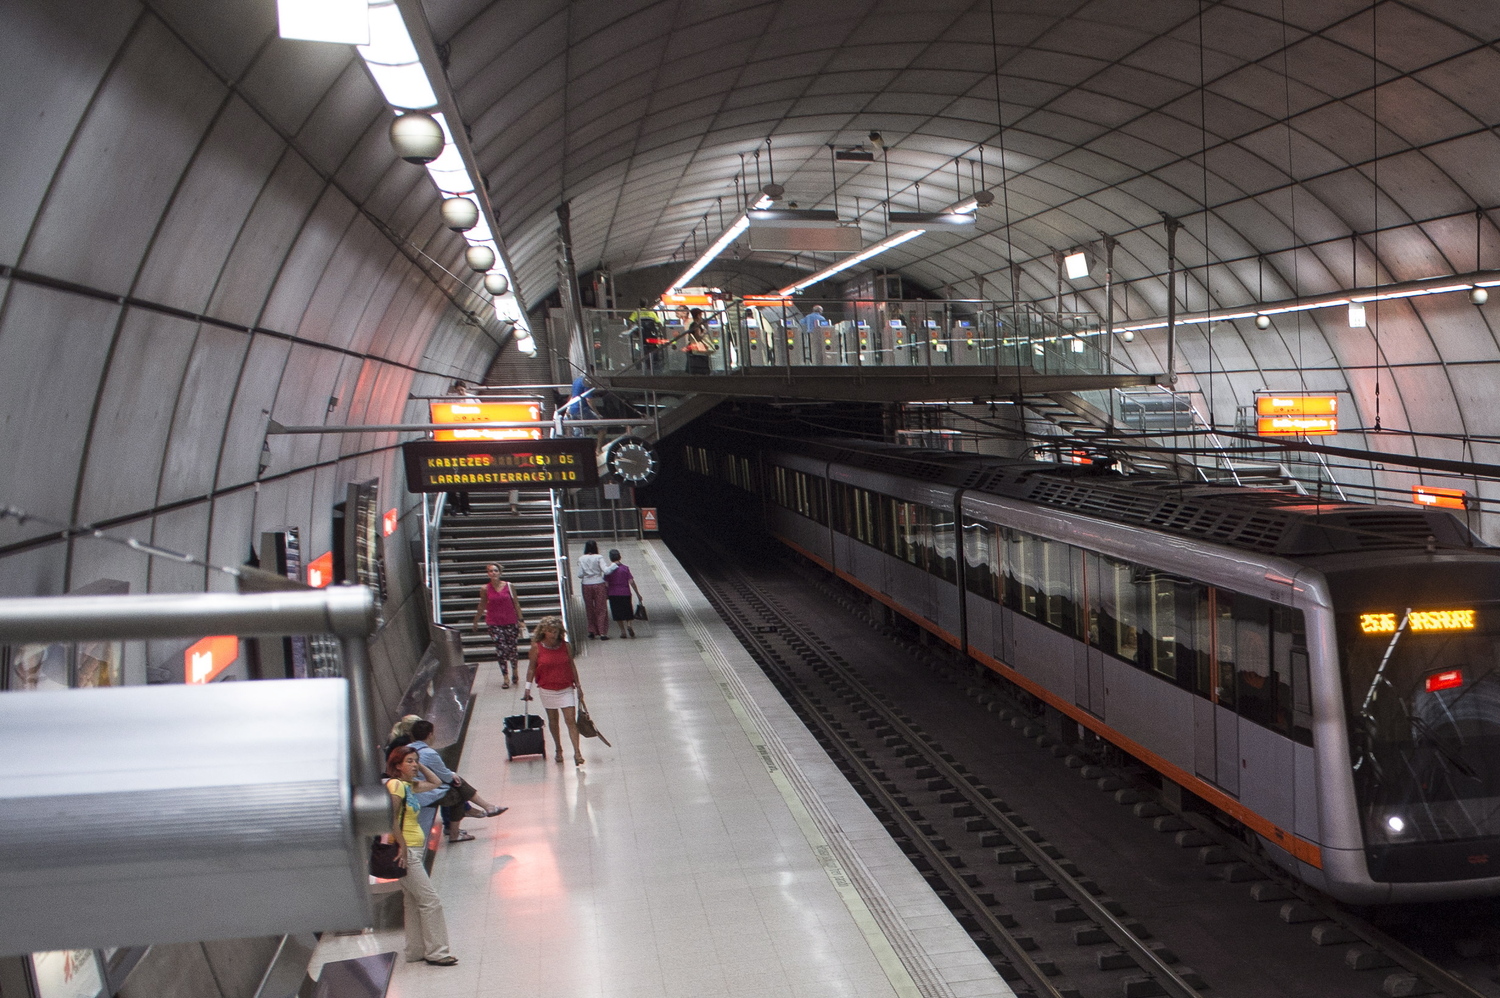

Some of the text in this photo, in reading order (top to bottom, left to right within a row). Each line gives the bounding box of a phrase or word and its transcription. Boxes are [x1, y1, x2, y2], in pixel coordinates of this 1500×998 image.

[428, 454, 575, 467] KABIEZES (5) 05
[561, 471, 577, 481] 10
